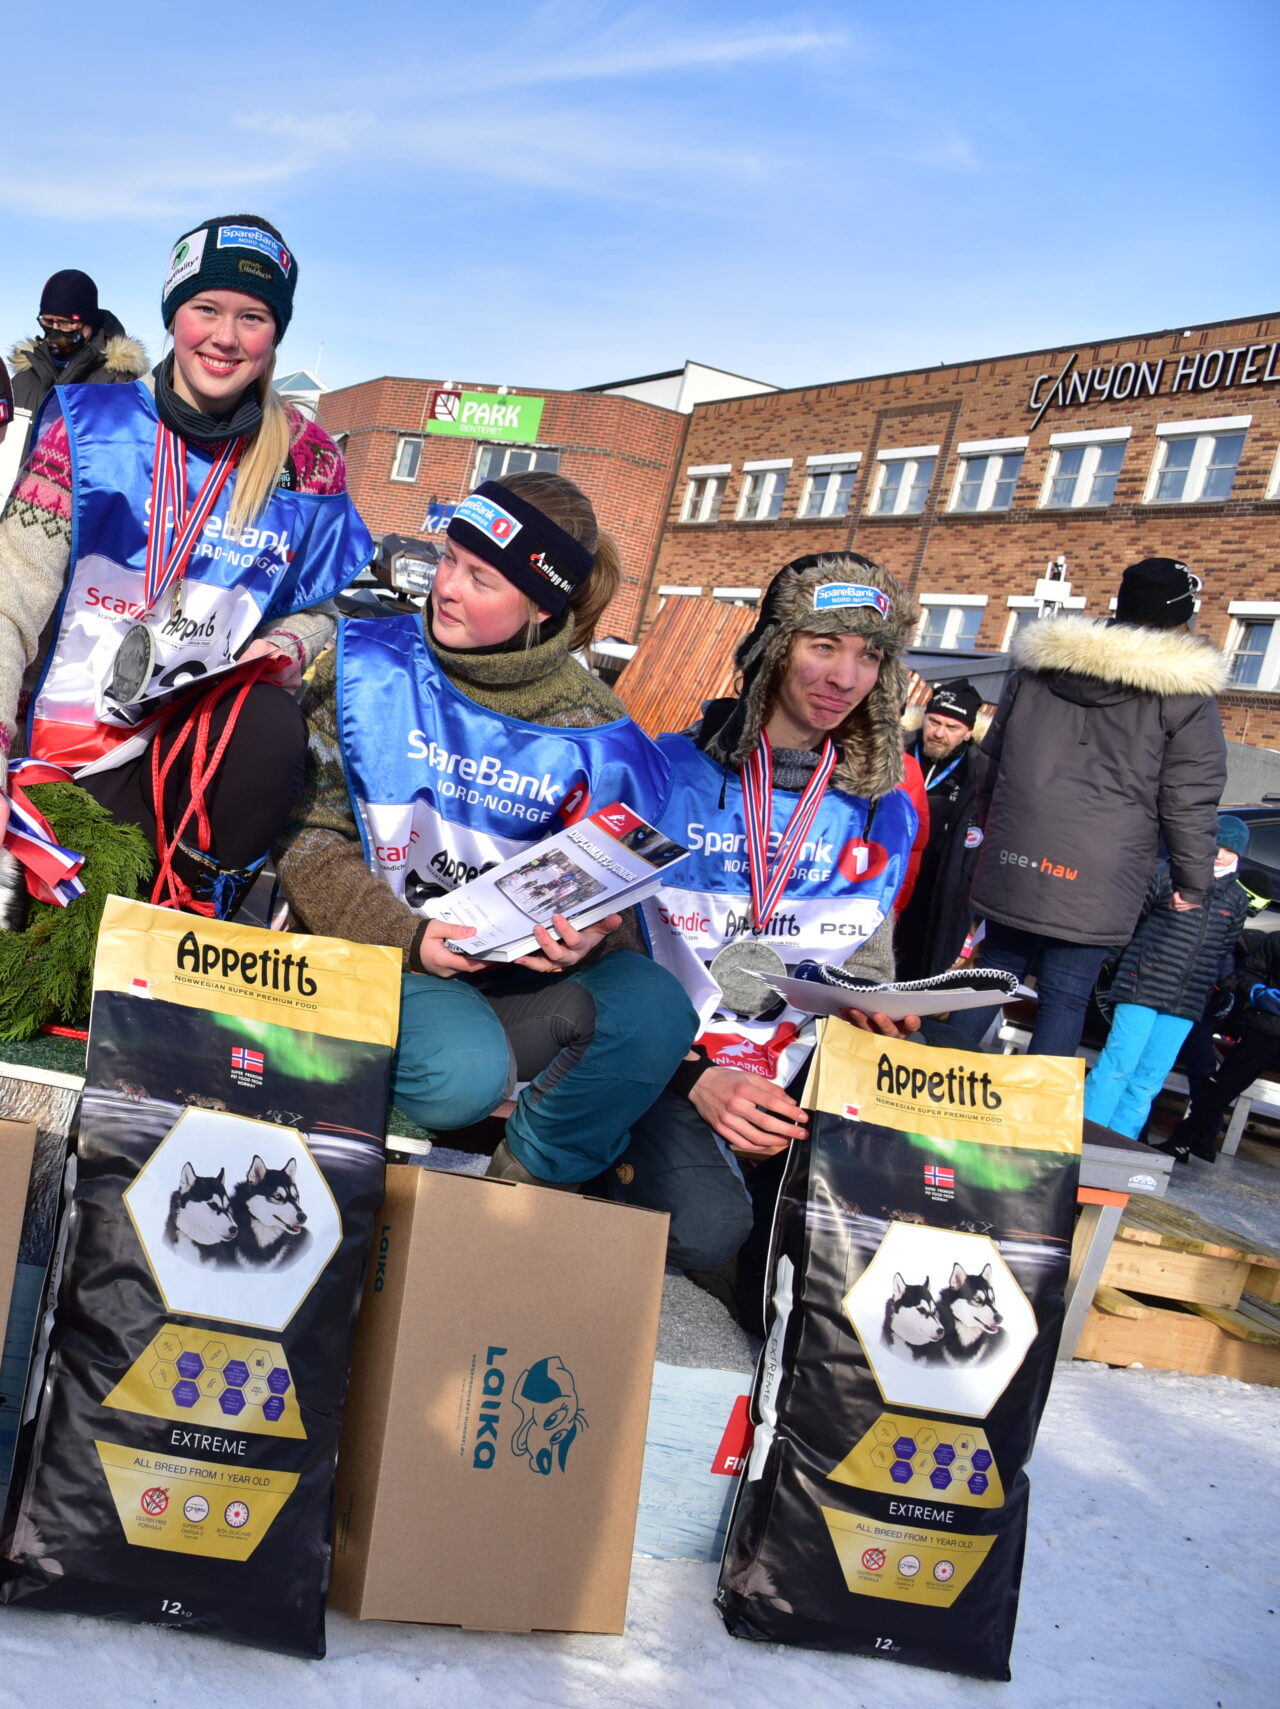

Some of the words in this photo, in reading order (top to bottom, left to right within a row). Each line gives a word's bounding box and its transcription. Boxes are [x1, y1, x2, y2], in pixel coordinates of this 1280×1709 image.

[223, 229, 279, 251] SpareBank
[1029, 353, 1166, 431] CANYON
[1172, 342, 1280, 393] HOTEL
[461, 401, 522, 428] PARK
[420, 515, 450, 534] KP
[818, 587, 875, 599] SpareBank
[567, 829, 603, 859] DIPLOMA
[608, 863, 638, 883] JUNIOR
[851, 846, 870, 876] 1
[176, 930, 318, 997] Appetitt
[174, 974, 226, 991] NORWEGIAN
[228, 986, 255, 997] SUPER
[256, 992, 293, 1006] PREMIUM
[295, 1001, 318, 1010] FOOD
[877, 1053, 1002, 1110] Appetitt
[876, 1097, 916, 1112] NORWEGIAN
[917, 1107, 942, 1116] SUPER
[944, 1111, 979, 1121] PREMIUM
[763, 1338, 779, 1404] EXTREME
[473, 1346, 508, 1470] Laika
[171, 1429, 247, 1456] EXTREME
[133, 1457, 151, 1469] ALL
[154, 1461, 187, 1475] BREED
[189, 1467, 217, 1480] FROM
[227, 1473, 250, 1484] YEAR
[252, 1477, 271, 1487] OLD
[888, 1501, 955, 1524] EXTREME
[856, 1523, 872, 1533] ALL
[874, 1527, 903, 1539] BREED
[904, 1532, 928, 1543] FROM
[936, 1538, 957, 1548] YEAR
[958, 1540, 973, 1549] OLD
[161, 1599, 182, 1615] 12
[181, 1610, 193, 1618] kg
[874, 1637, 893, 1651] 12
